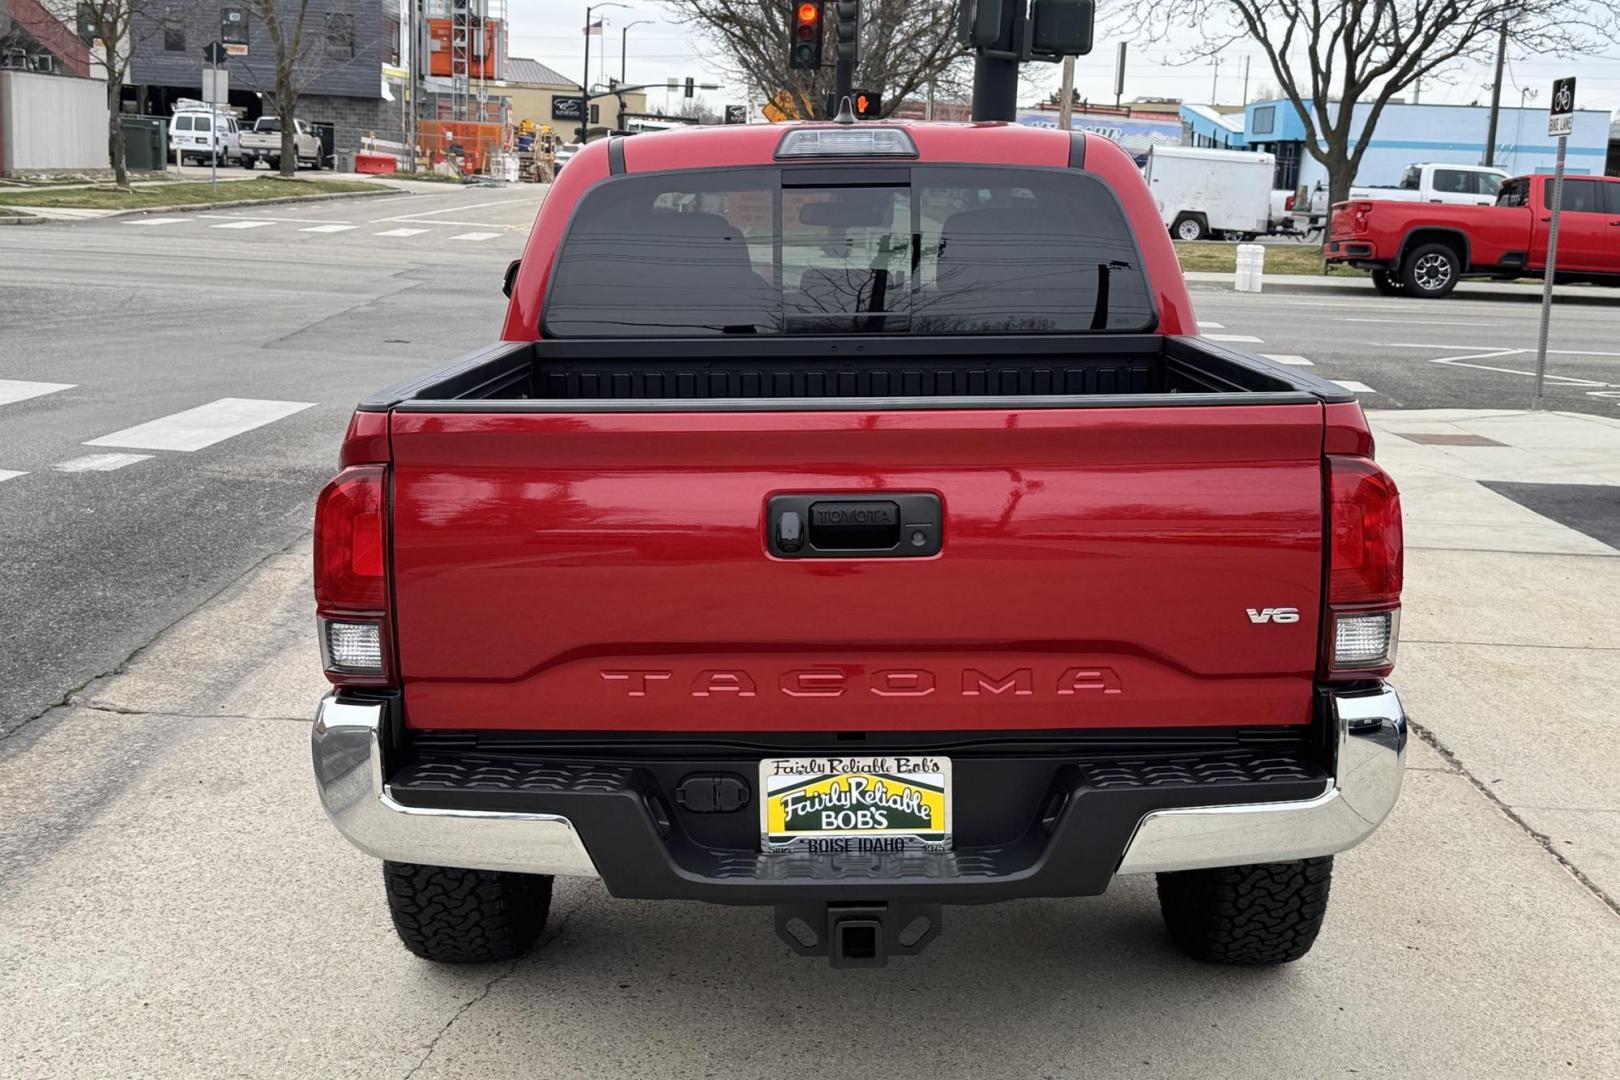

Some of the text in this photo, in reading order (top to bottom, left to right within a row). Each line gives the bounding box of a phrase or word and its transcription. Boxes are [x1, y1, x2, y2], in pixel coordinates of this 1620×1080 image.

[1549, 116, 1572, 132] BIKE LANE
[817, 508, 891, 523] TOYOTA
[1245, 607, 1300, 624] V6
[600, 667, 1123, 697] TACOMA
[772, 757, 940, 775] Fairly Reliable Bob's
[782, 776, 932, 820] Fairly Reliable
[821, 806, 888, 830] BOB'S
[808, 837, 906, 853] BOISE IDAHO
